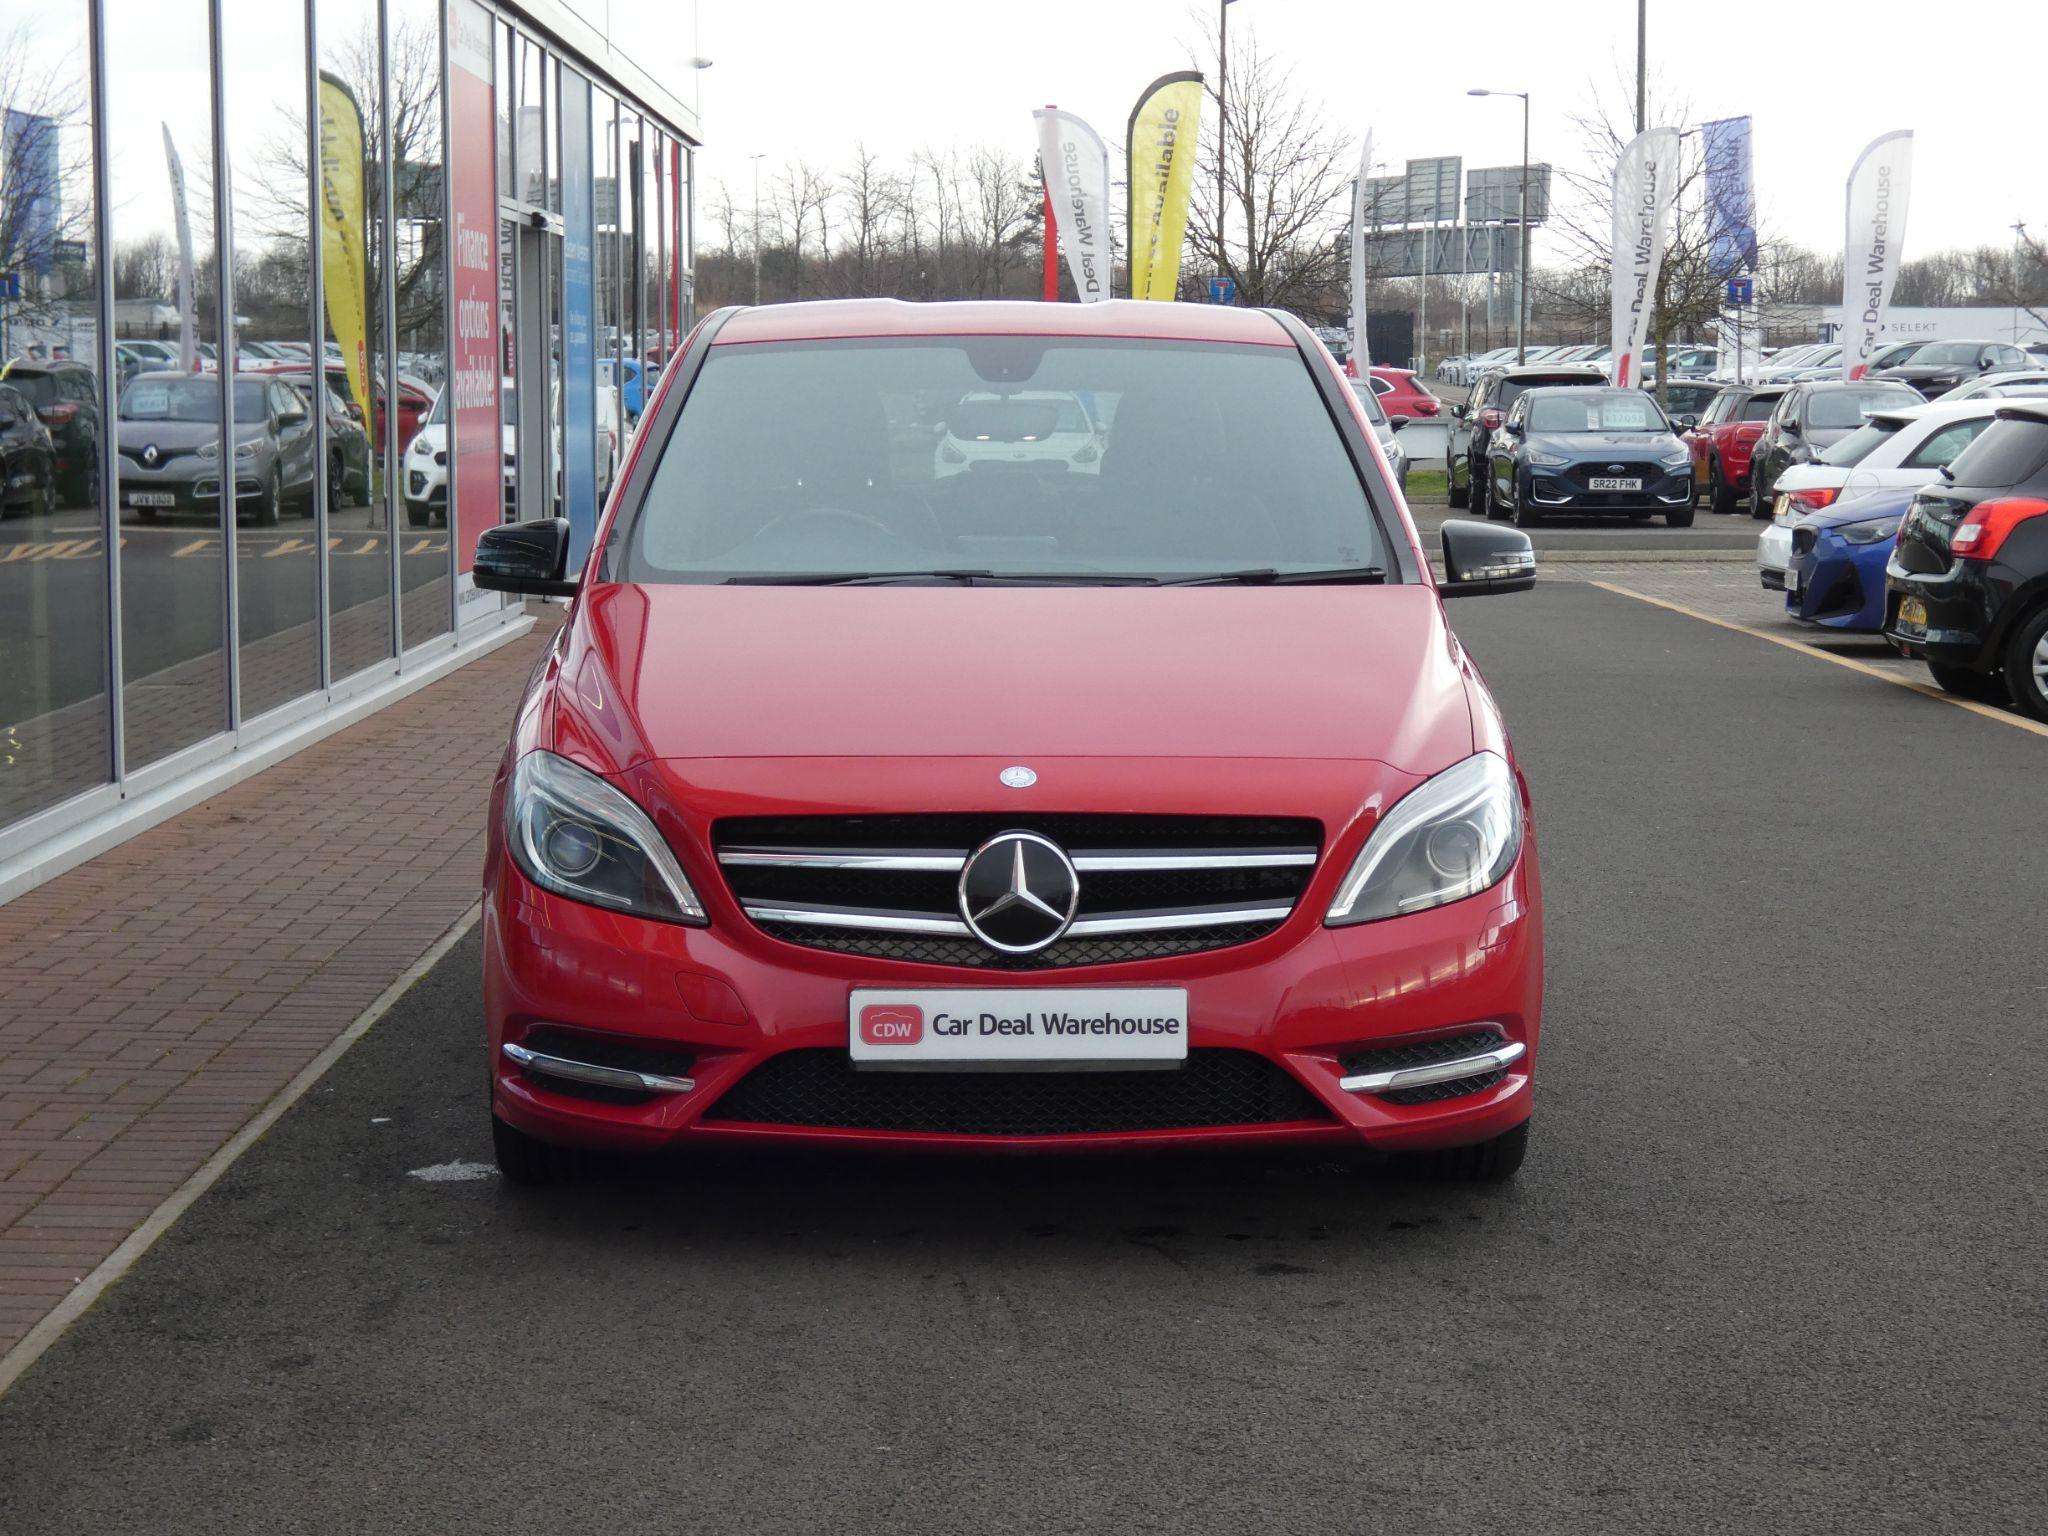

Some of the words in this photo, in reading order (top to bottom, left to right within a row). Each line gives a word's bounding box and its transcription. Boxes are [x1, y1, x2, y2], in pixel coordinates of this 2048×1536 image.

[1152, 108, 1180, 226] available
[1634, 160, 1657, 267] Warehouse
[1867, 165, 1891, 275] Warehouse
[456, 212, 489, 272] Finance
[1631, 271, 1650, 314] Deal
[1862, 280, 1883, 324] Deal
[459, 284, 490, 356] options
[1891, 322, 1938, 333] SELEKT
[1859, 328, 1876, 359] Car
[455, 355, 495, 410] available!
[1592, 479, 1618, 489] SR22
[1619, 479, 1638, 489] FHK
[872, 1022, 912, 1038] CDW
[932, 1013, 973, 1036] Car
[979, 1012, 1034, 1036] Deal
[1040, 1012, 1180, 1036] Warehouse
